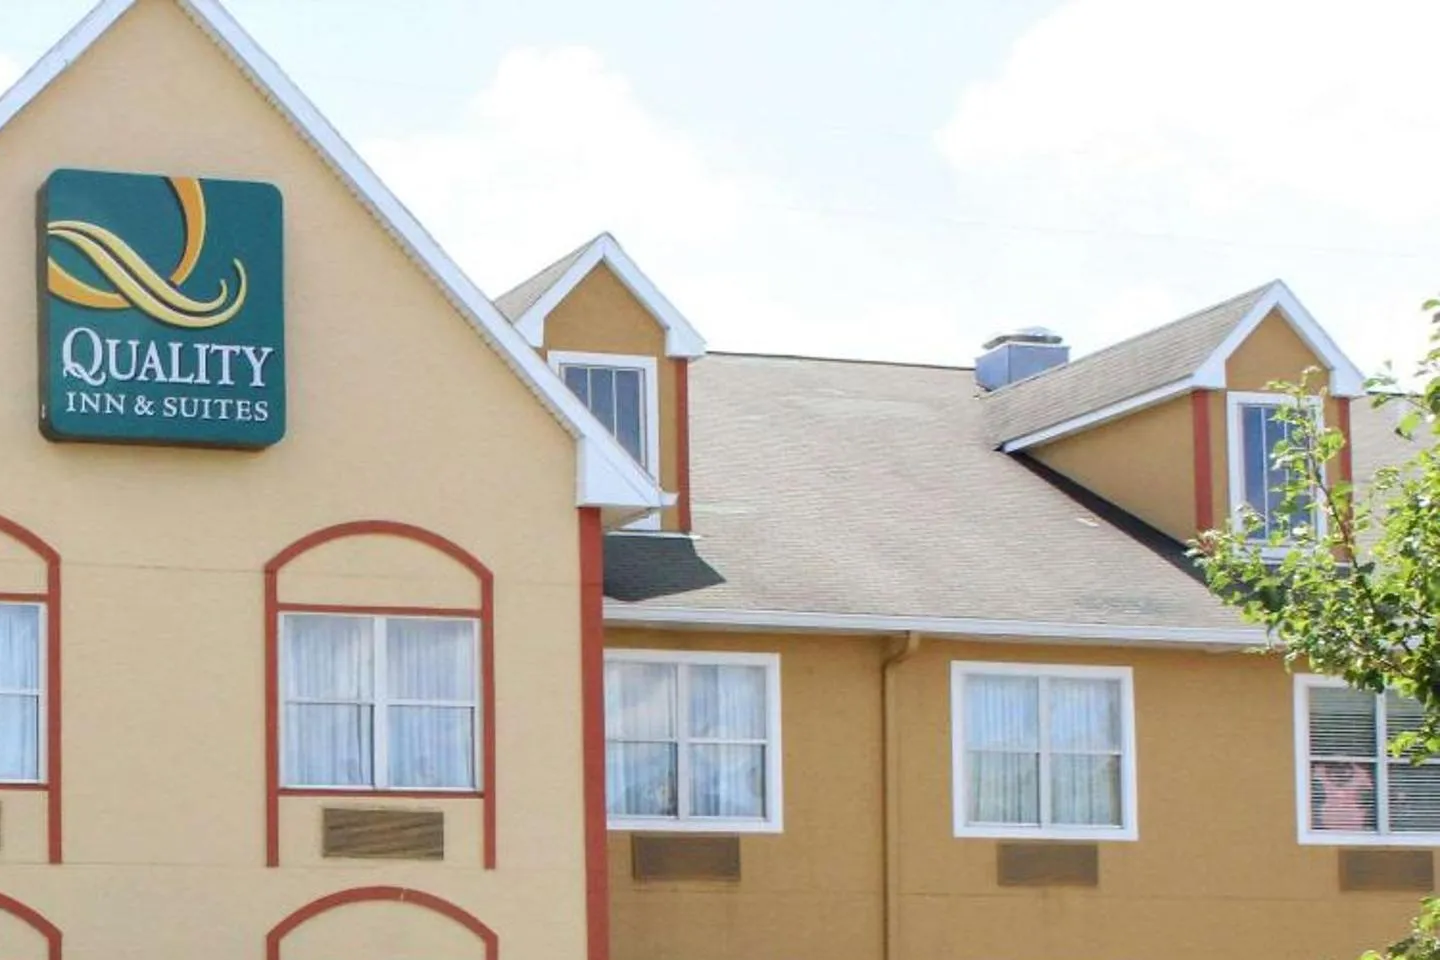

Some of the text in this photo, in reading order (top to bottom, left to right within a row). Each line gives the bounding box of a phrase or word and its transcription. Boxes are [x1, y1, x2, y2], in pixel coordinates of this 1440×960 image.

[62, 327, 273, 387] QUALITY
[66, 391, 269, 421] INN & SUITES
